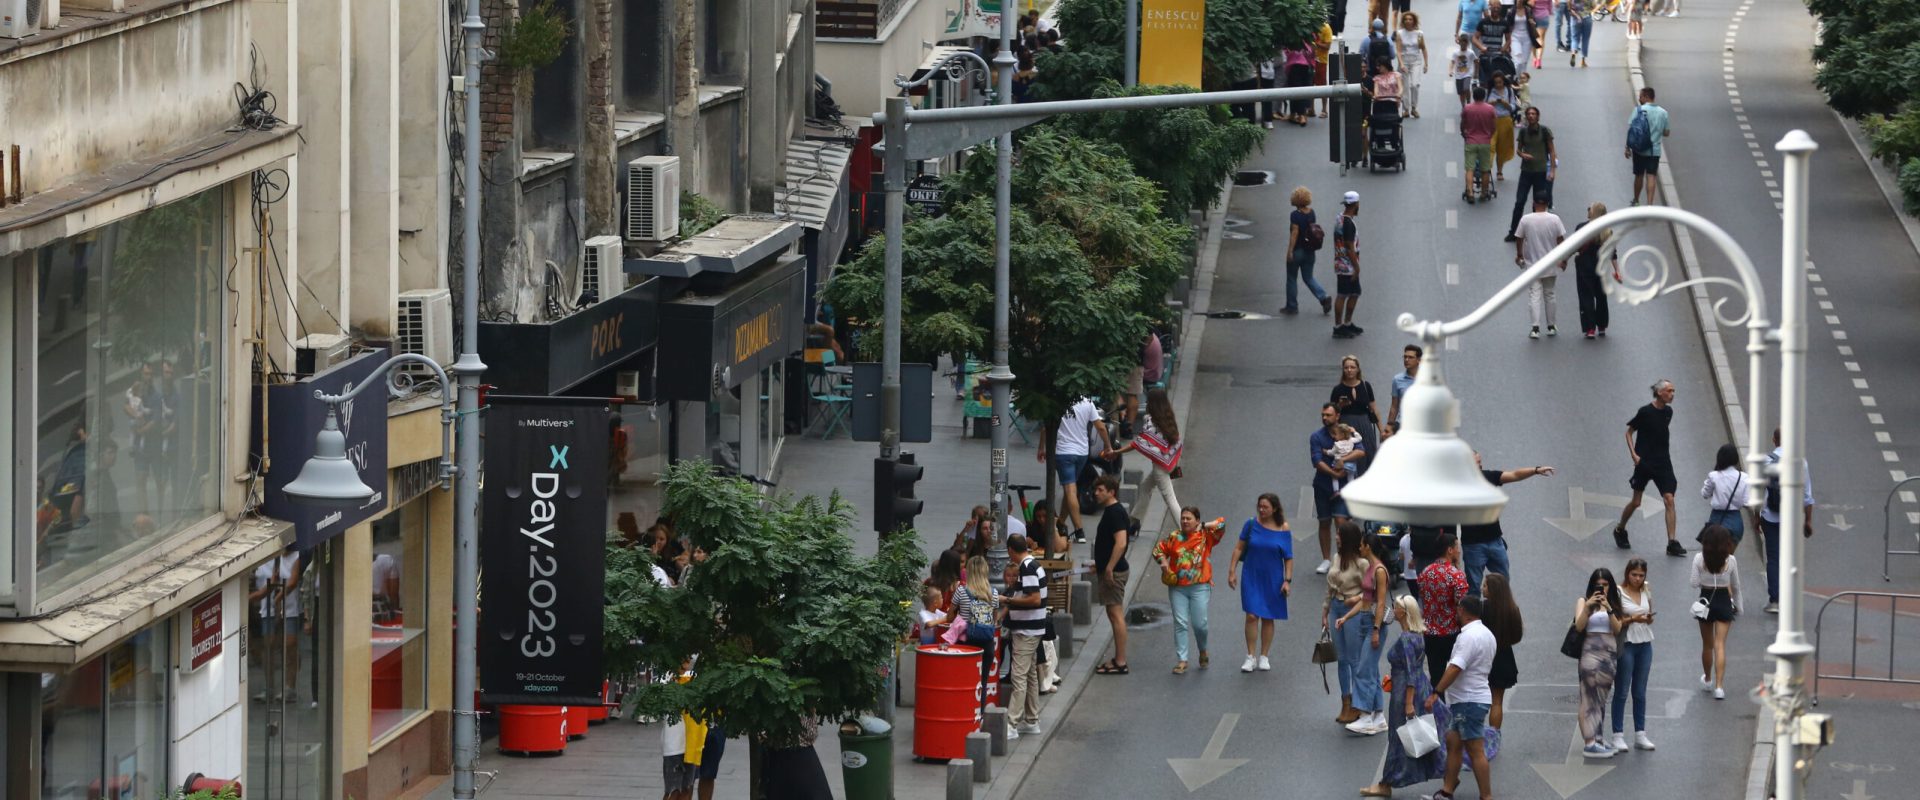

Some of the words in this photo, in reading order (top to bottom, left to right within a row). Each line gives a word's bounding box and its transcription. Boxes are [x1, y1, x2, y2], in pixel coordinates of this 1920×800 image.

[1147, 9, 1200, 21] ENESCU
[1147, 22, 1199, 30] FESTIVAL
[591, 312, 625, 361] PORC
[215, 630, 223, 646] 22
[535, 673, 566, 682] October
[524, 684, 559, 692] xday.com
